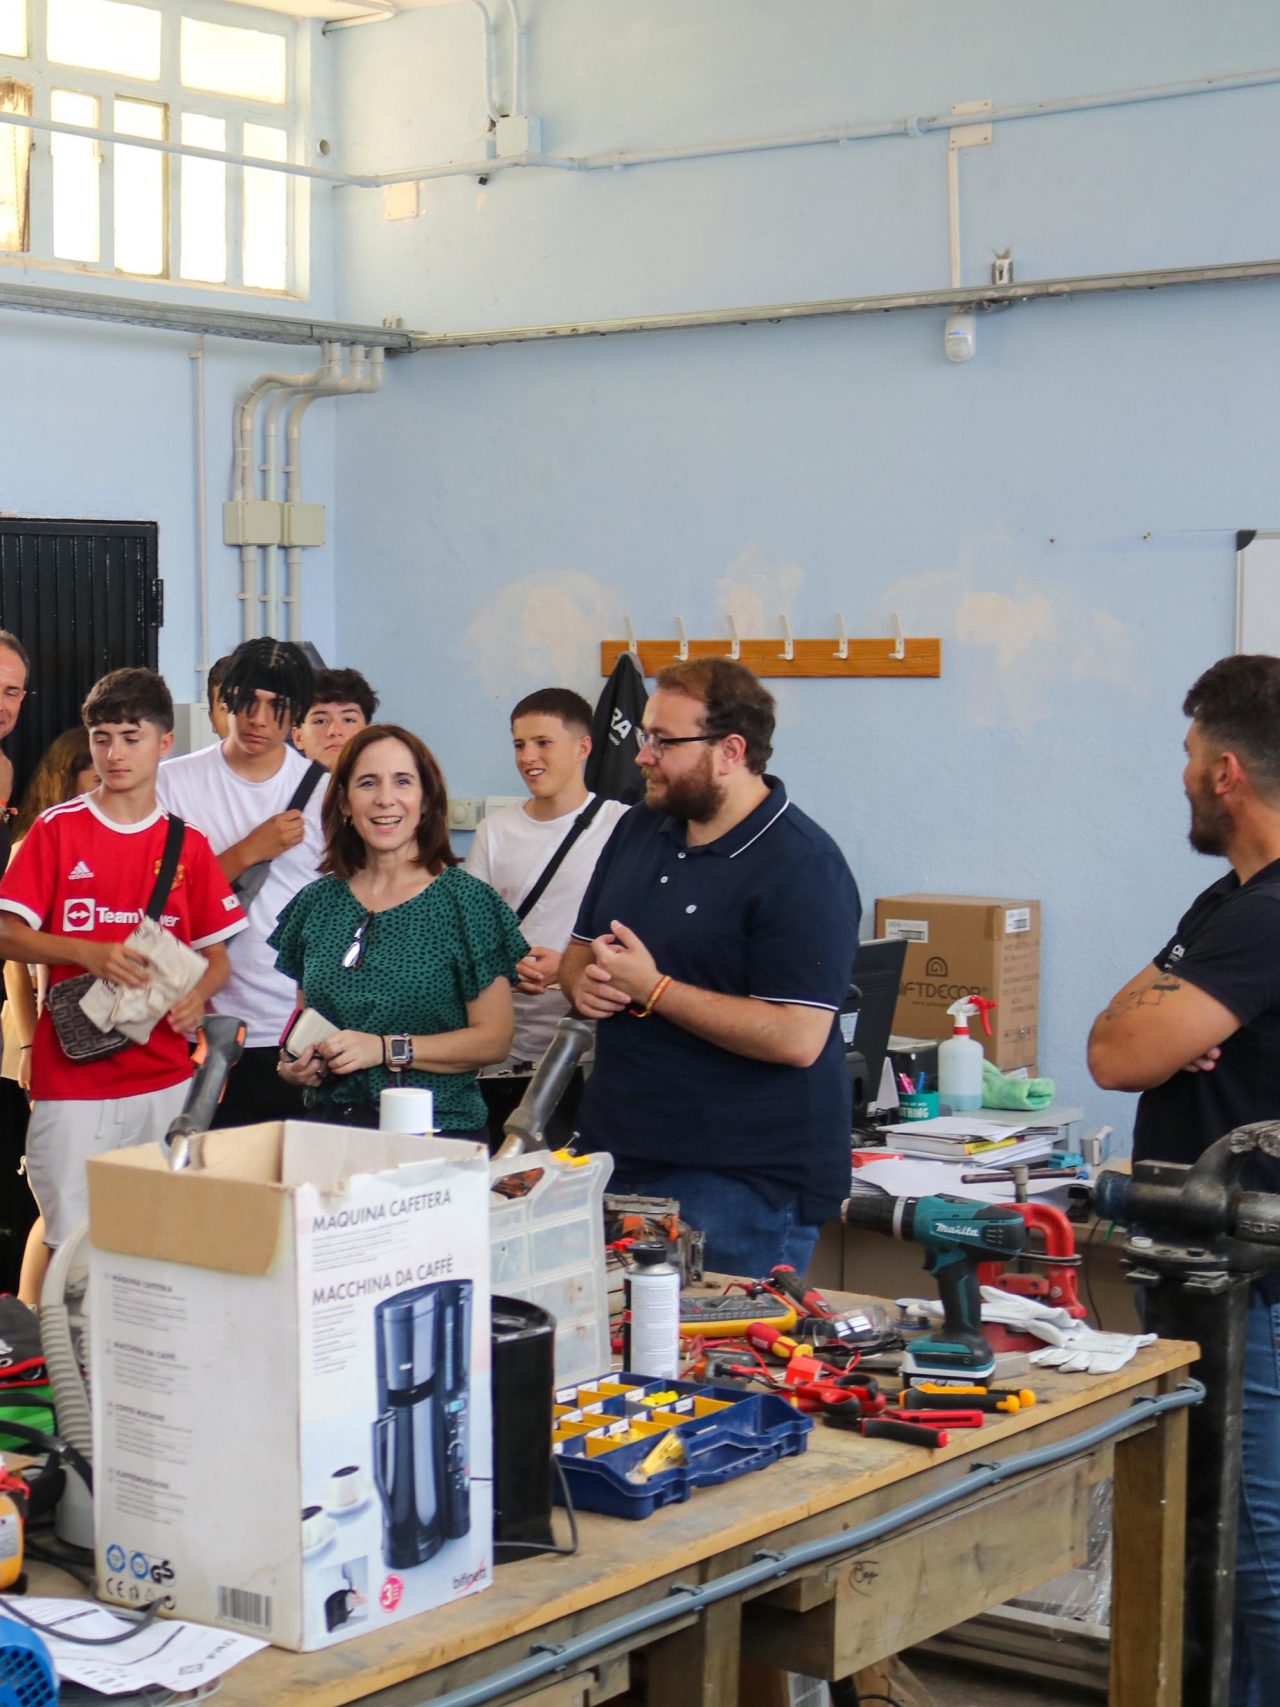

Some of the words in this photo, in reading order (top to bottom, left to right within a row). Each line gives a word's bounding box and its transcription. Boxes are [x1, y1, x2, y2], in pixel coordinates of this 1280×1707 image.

[389, 1189, 453, 1217] CAFETERA
[312, 1274, 392, 1305] MACCHINA
[395, 1268, 413, 1287] DA
[150, 1560, 175, 1584] GS
[381, 1584, 394, 1606] 3
